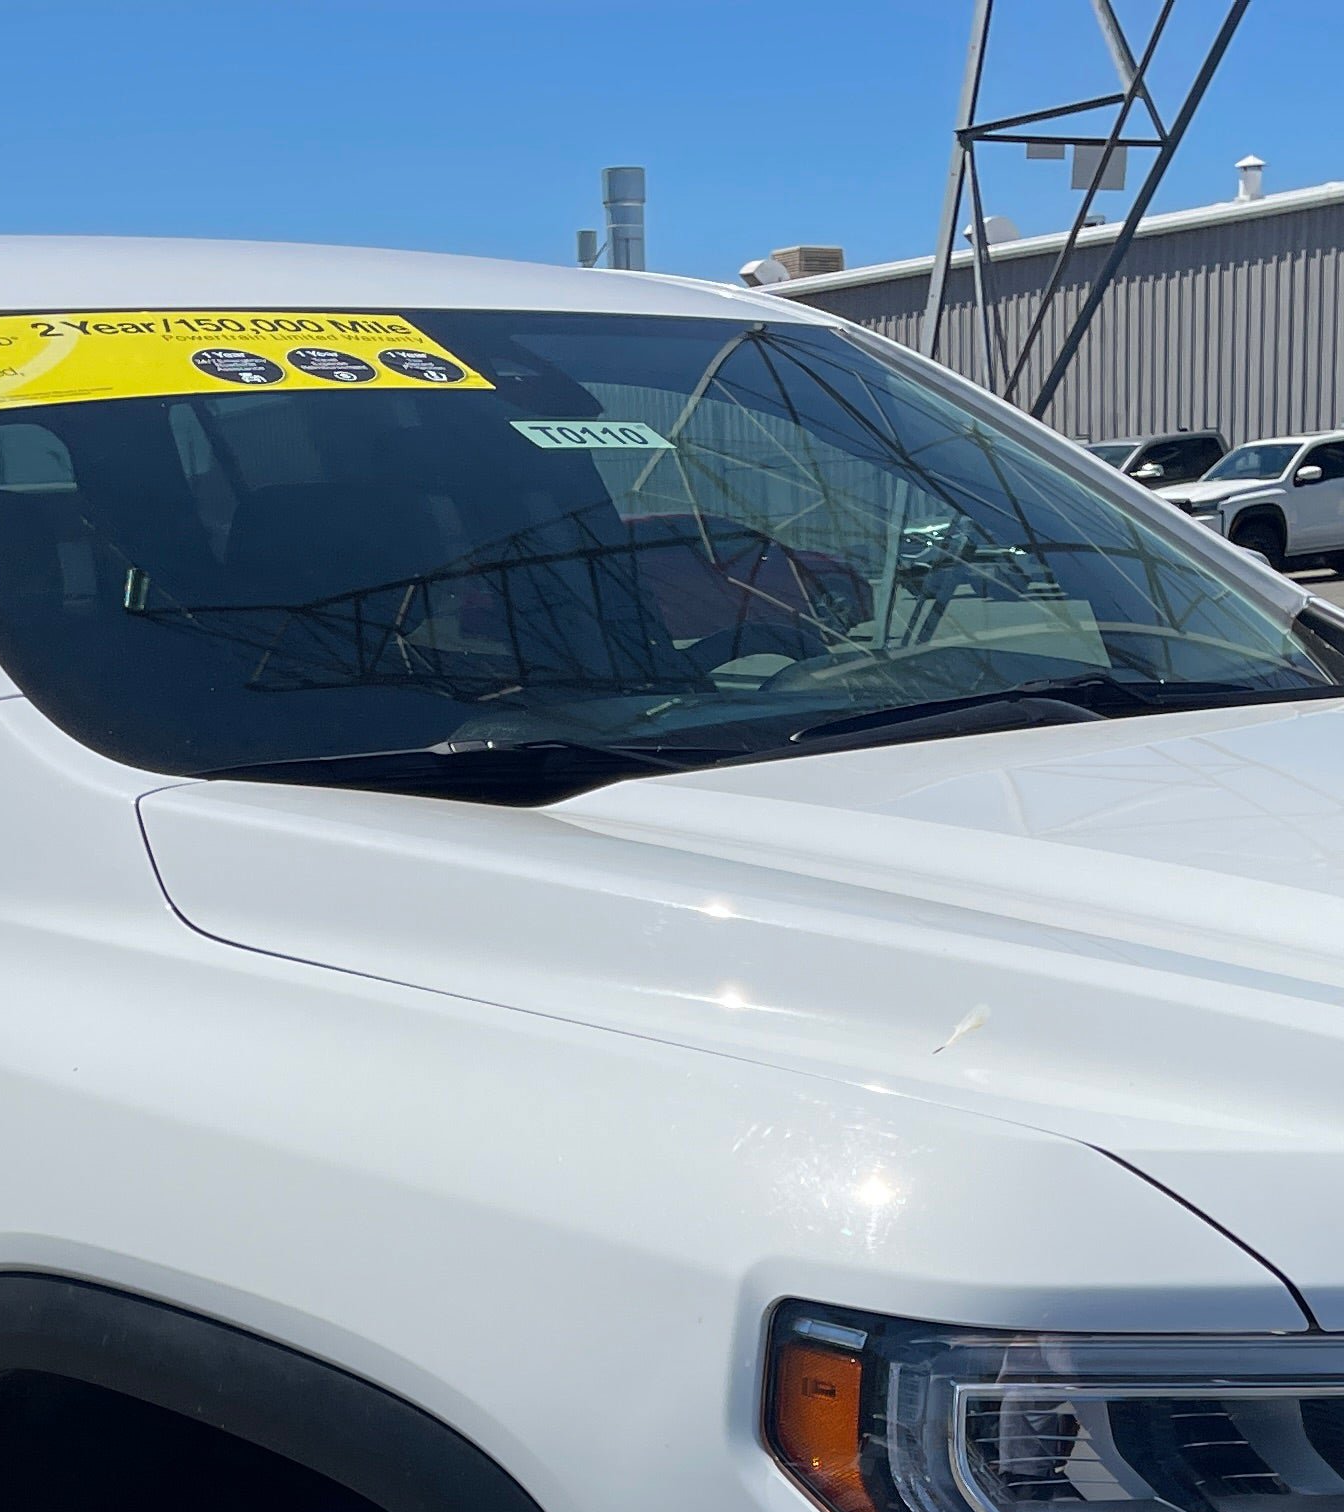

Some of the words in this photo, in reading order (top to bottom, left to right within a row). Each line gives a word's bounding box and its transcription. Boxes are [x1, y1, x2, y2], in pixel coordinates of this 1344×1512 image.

[31, 321, 63, 338] 2
[327, 319, 413, 335] Mile
[162, 334, 266, 343] Powertrain
[272, 334, 336, 342] Limited
[343, 335, 424, 345] Warranty
[211, 351, 246, 359] Year
[306, 350, 339, 358] Year
[396, 351, 427, 359] Year
[527, 425, 649, 446] T0110
